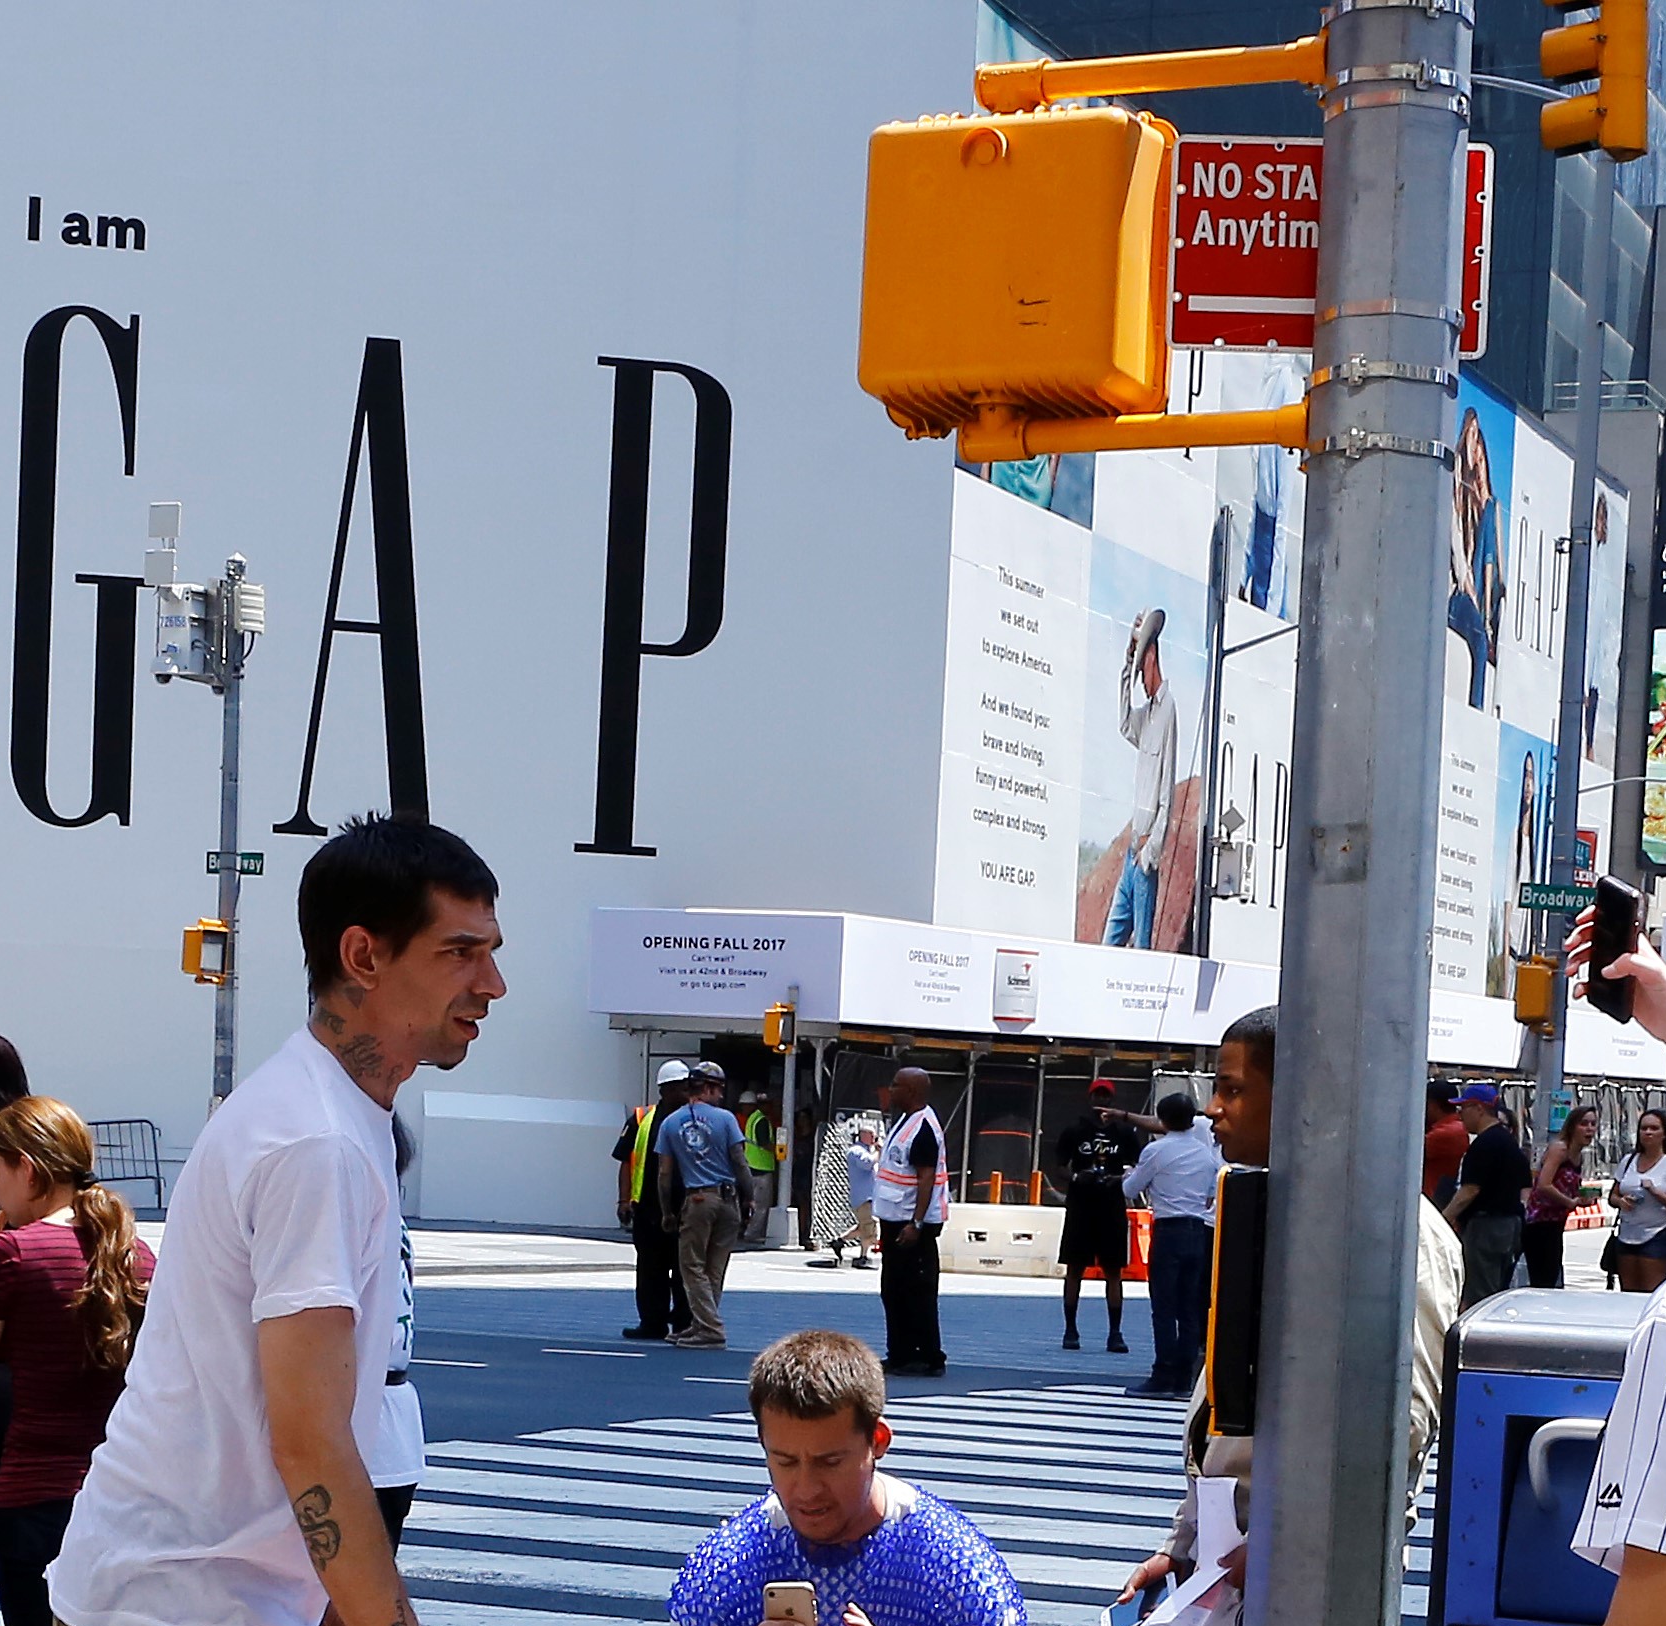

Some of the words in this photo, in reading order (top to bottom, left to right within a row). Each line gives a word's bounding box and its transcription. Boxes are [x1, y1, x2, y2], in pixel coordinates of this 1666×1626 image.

[1191, 161, 1243, 199] NO
[1253, 162, 1319, 201] STA
[26, 196, 41, 242] I
[61, 211, 147, 251] am
[1191, 209, 1319, 256] Anytim
[10, 304, 734, 857] GAP
[998, 565, 1013, 587] This
[1015, 577, 1045, 599] summer
[1000, 609, 1011, 624] we
[1013, 613, 1025, 629] set
[1026, 619, 1039, 634] out
[982, 637, 990, 654] to
[992, 643, 1020, 664] explore
[1021, 650, 1054, 676] America.
[981, 692, 997, 712] And
[998, 701, 1009, 716] we
[1011, 701, 1033, 723] found
[982, 730, 1003, 751] brave
[1004, 740, 1019, 756] and
[1020, 741, 1045, 767] loving,
[976, 766, 997, 791] funny
[998, 776, 1013, 791] and
[1014, 779, 1049, 803] powerful,
[973, 806, 1005, 827] complex
[1006, 815, 1020, 830] and
[1021, 819, 1049, 841] strong.
[980, 860, 998, 880] YOU
[999, 864, 1016, 883] ARE
[1017, 868, 1037, 888] GAP.
[1520, 886, 1595, 908] Broadway
[642, 936, 710, 949] OPENING
[714, 937, 749, 950] FALL
[753, 938, 786, 951] 2017
[659, 966, 676, 975] Visit
[699, 967, 719, 975] 42nd
[728, 968, 768, 978] Broadway
[712, 982, 746, 990] gap.com
